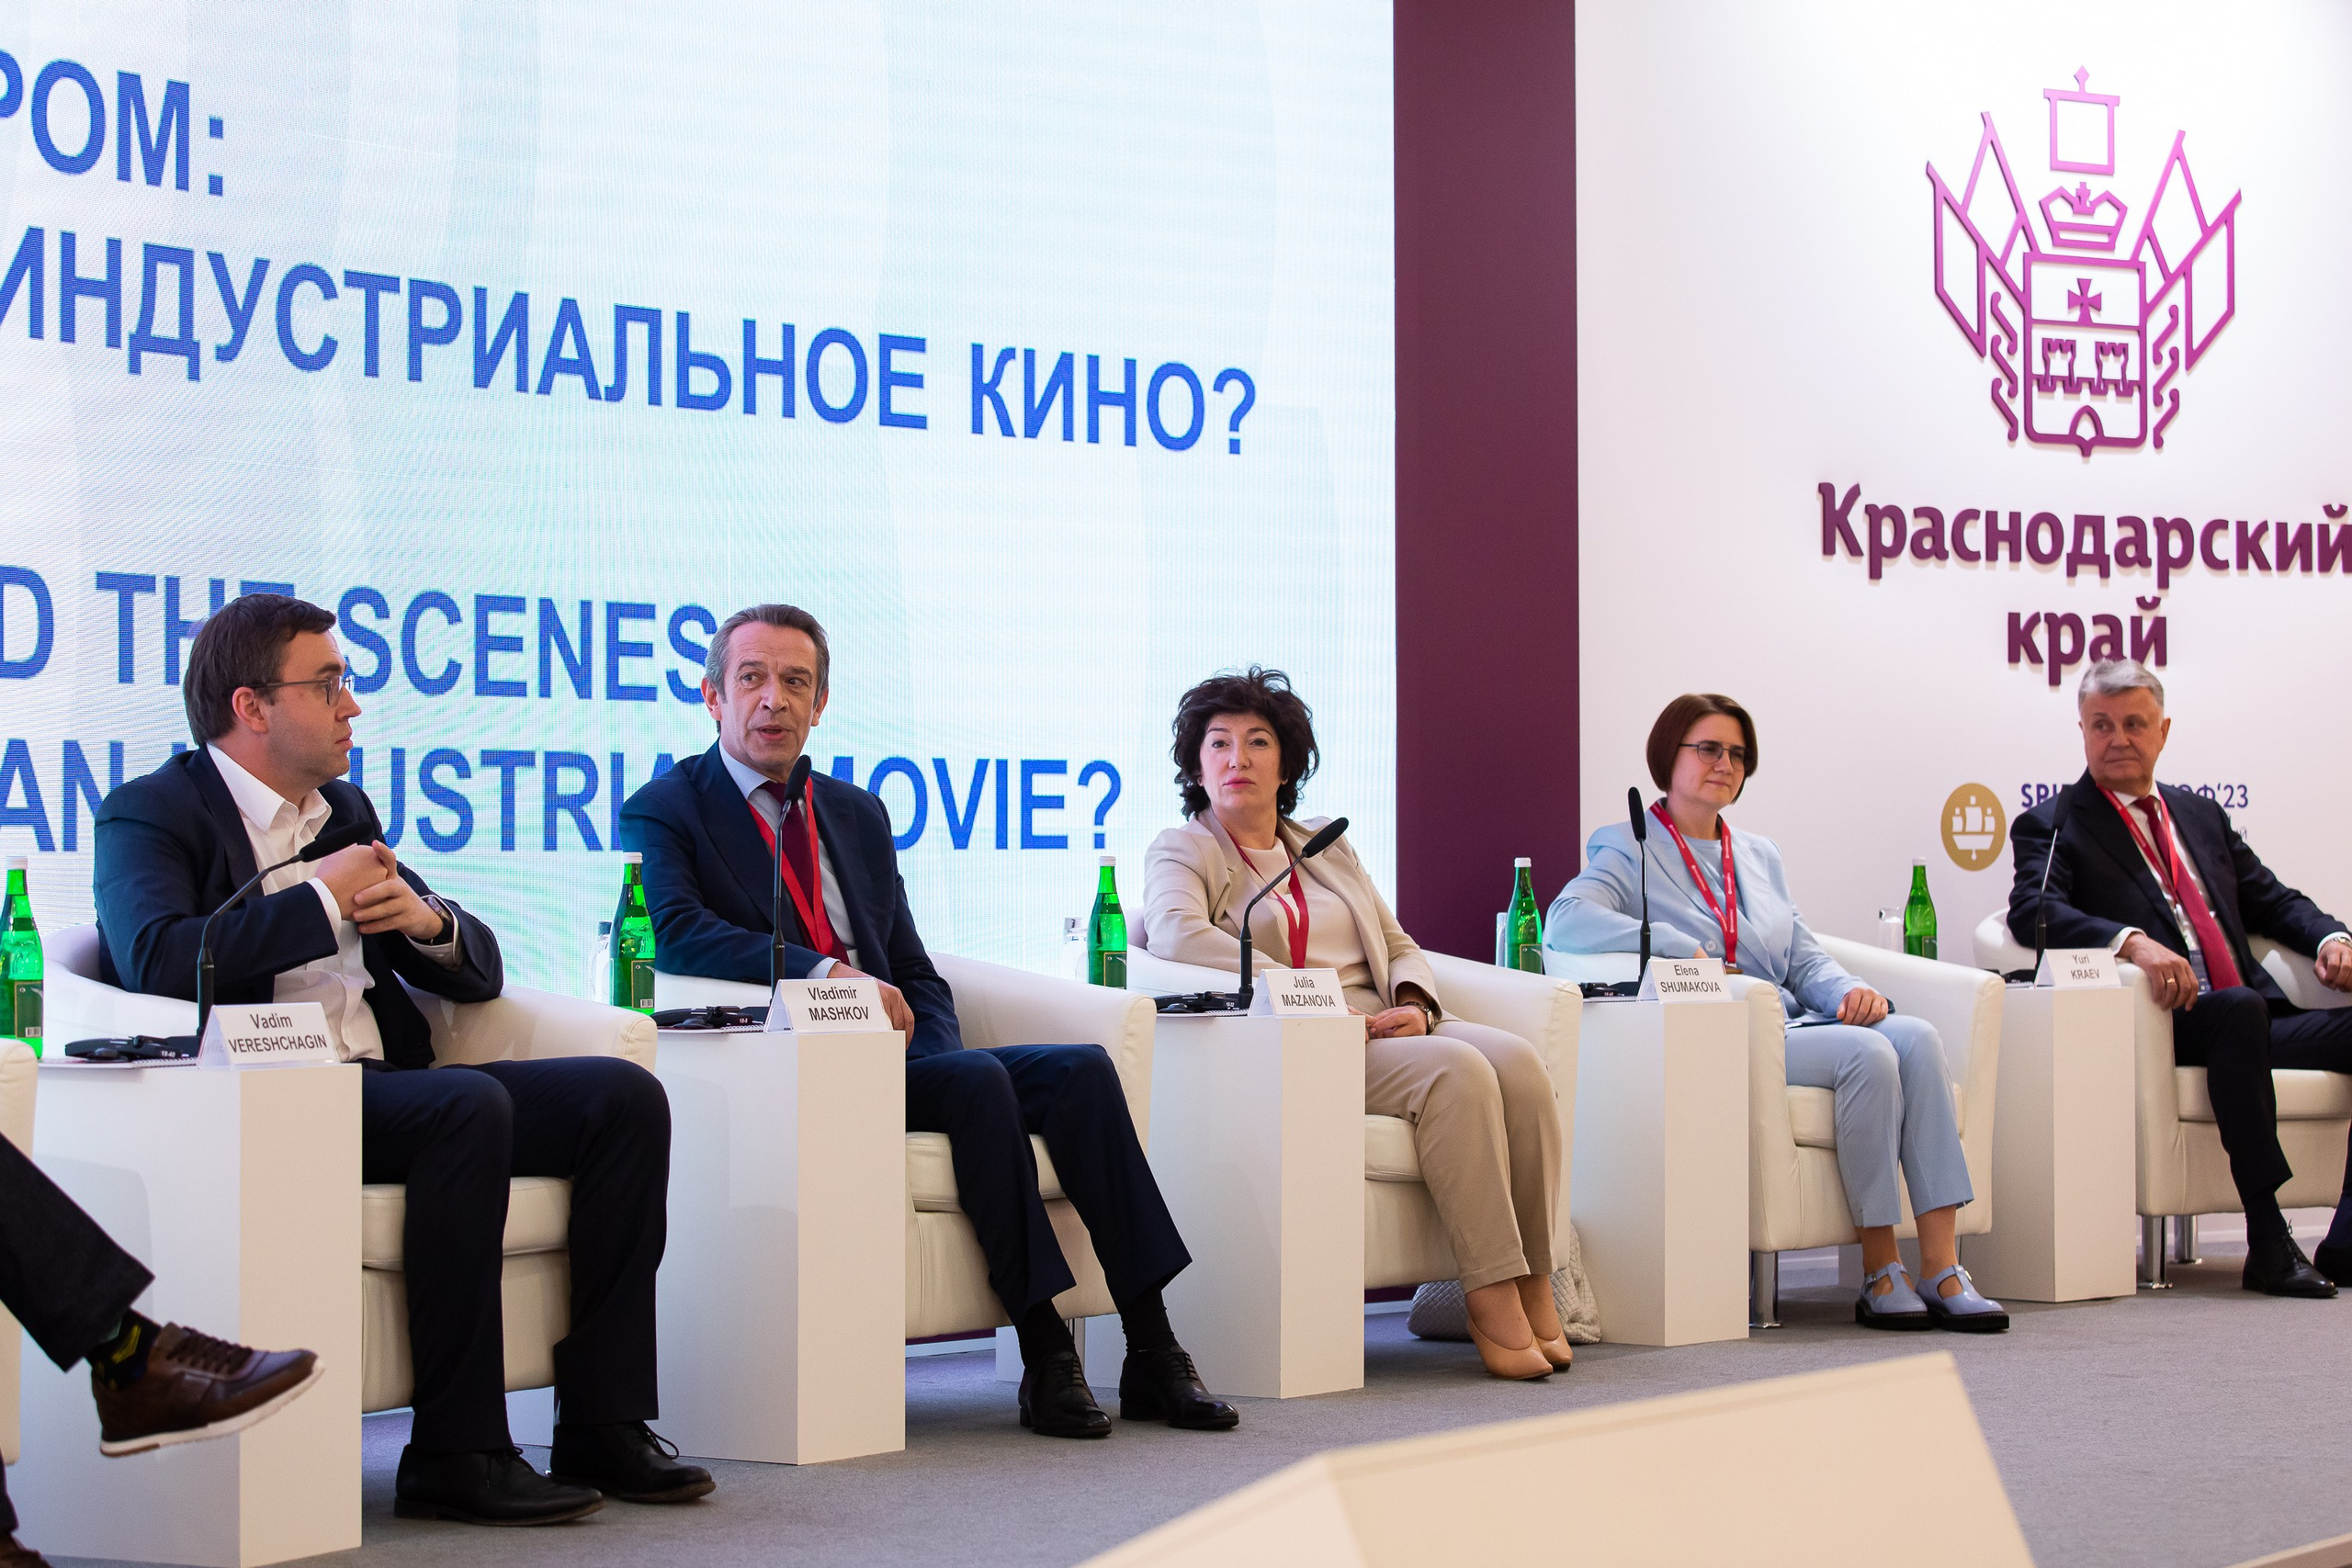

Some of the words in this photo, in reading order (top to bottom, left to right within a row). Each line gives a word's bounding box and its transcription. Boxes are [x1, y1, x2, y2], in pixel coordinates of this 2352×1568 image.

[970, 342, 1257, 455] КИНО?
[1818, 482, 2352, 590] Краснодарский
[95, 570, 296, 685] TH
[337, 585, 718, 705] SCENES
[2007, 595, 2167, 686] край
[830, 755, 1122, 852] OVIE?
[2071, 953, 2090, 964] Yuri
[1674, 964, 1700, 976] Elena
[2070, 968, 2100, 980] KRAEV
[1293, 976, 1316, 988] Julia
[1660, 981, 1722, 993] SHUMAKOVA
[808, 987, 857, 1001] Vladimir
[1281, 994, 1336, 1008] MAZANOVA
[808, 1006, 869, 1021] MASHKOV
[250, 1013, 293, 1030] Vadim
[228, 1034, 328, 1054] VERESHCHAGIN
